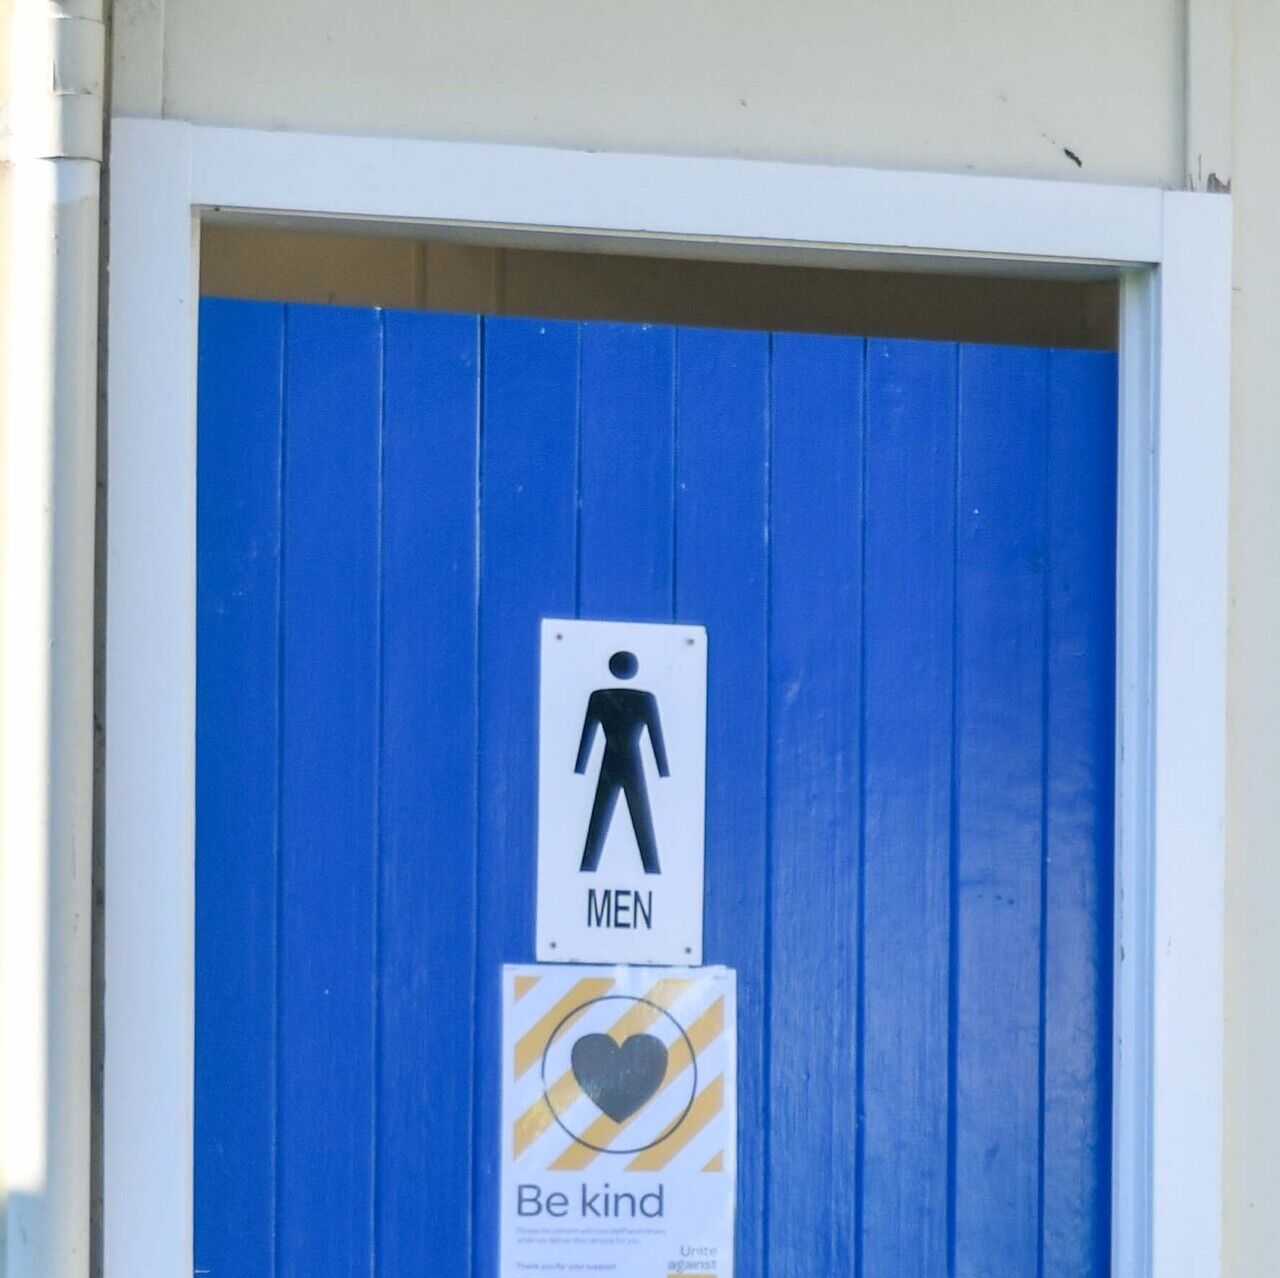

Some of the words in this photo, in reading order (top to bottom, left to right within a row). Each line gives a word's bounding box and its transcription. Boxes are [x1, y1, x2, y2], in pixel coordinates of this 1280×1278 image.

[587, 888, 652, 929] MEN
[517, 1183, 569, 1218] Be
[581, 1182, 664, 1218] kind
[680, 1245, 718, 1257] Unite
[668, 1258, 717, 1272] against
